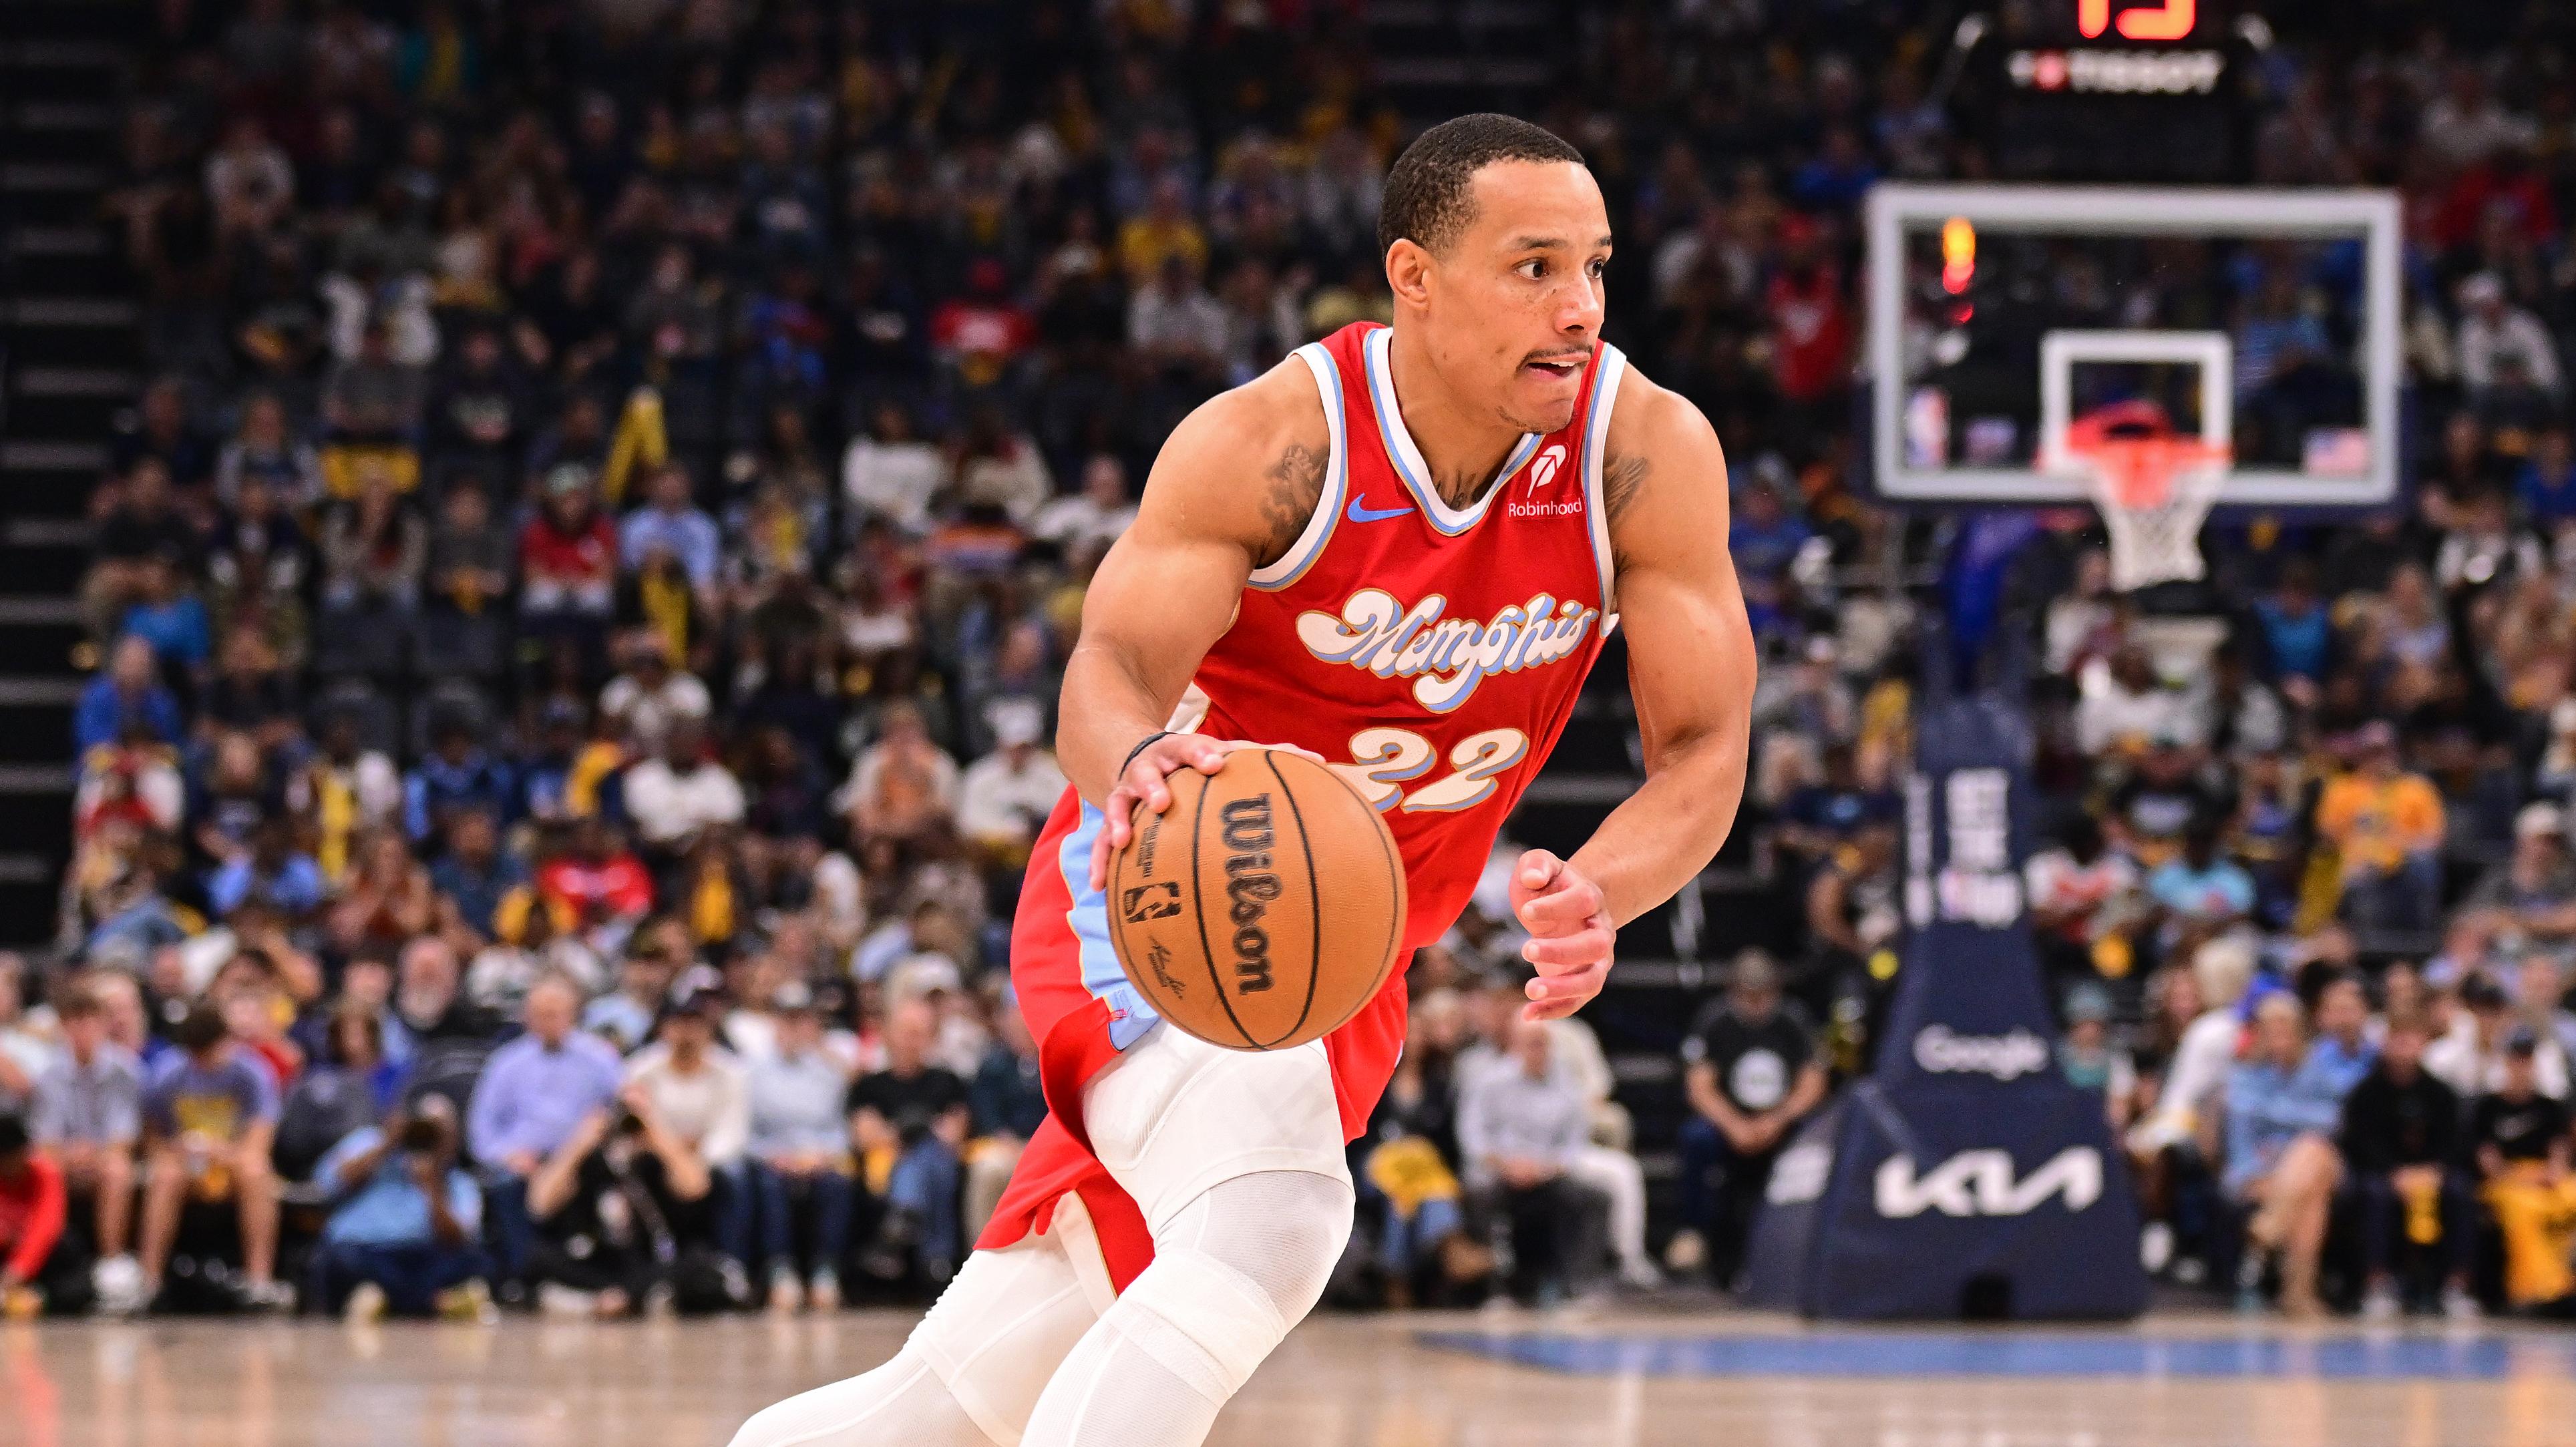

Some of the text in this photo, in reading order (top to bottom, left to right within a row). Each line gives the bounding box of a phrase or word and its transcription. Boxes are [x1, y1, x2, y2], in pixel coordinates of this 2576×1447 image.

[1508, 499, 1583, 518] Robinhood
[1295, 588, 1600, 714] Memphis
[1326, 727, 1530, 813] 22
[1220, 793, 1284, 996] Wilson
